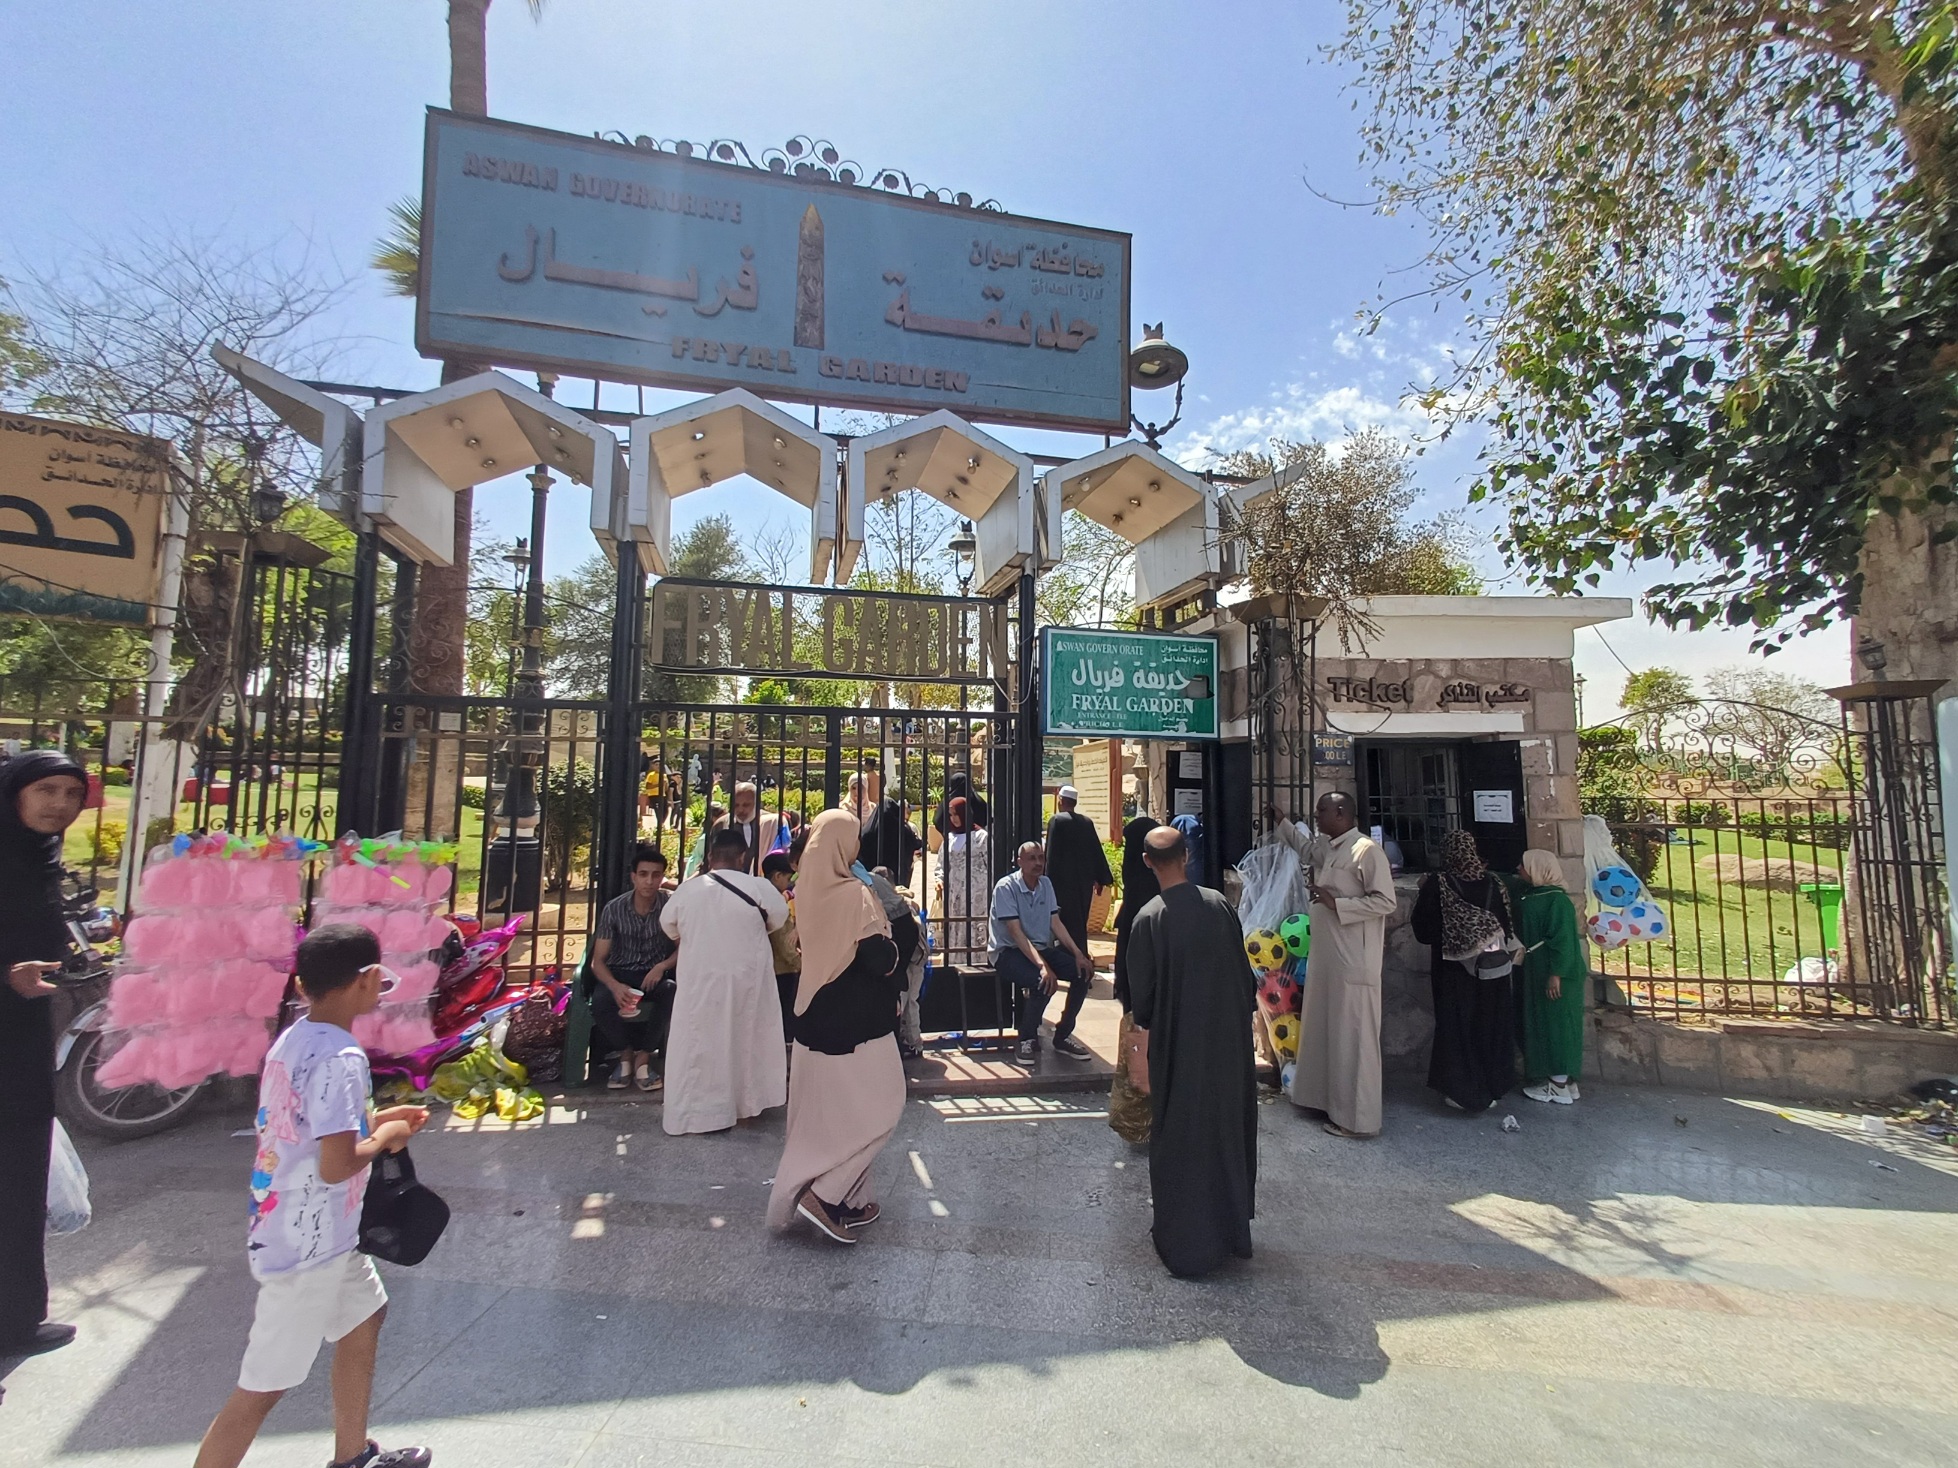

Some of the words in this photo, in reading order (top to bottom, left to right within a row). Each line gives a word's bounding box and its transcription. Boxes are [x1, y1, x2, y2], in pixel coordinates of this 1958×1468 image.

[463, 153, 558, 192] ASWAN
[569, 172, 742, 224] GOVERNORATE
[498, 224, 758, 316] فريال
[969, 239, 1024, 269] اسوان
[1025, 241, 1105, 279] محافظة
[882, 270, 1099, 352] حديقة
[671, 335, 797, 373] FRYAL
[818, 355, 971, 393] GARDEN
[653, 586, 812, 668] FRYAL
[822, 595, 1009, 679] GARDEN
[1056, 640, 1085, 653] ASWAN
[1182, 644, 1208, 654] محافظة
[1071, 658, 1125, 694] فريال
[1132, 661, 1191, 696] حديقة
[1328, 677, 1414, 703] Ticket
[1071, 694, 1122, 711] FRYAL
[1126, 697, 1194, 715] GARDEN
[1485, 683, 1532, 709] مكتب
[1315, 738, 1350, 748] PRICE
